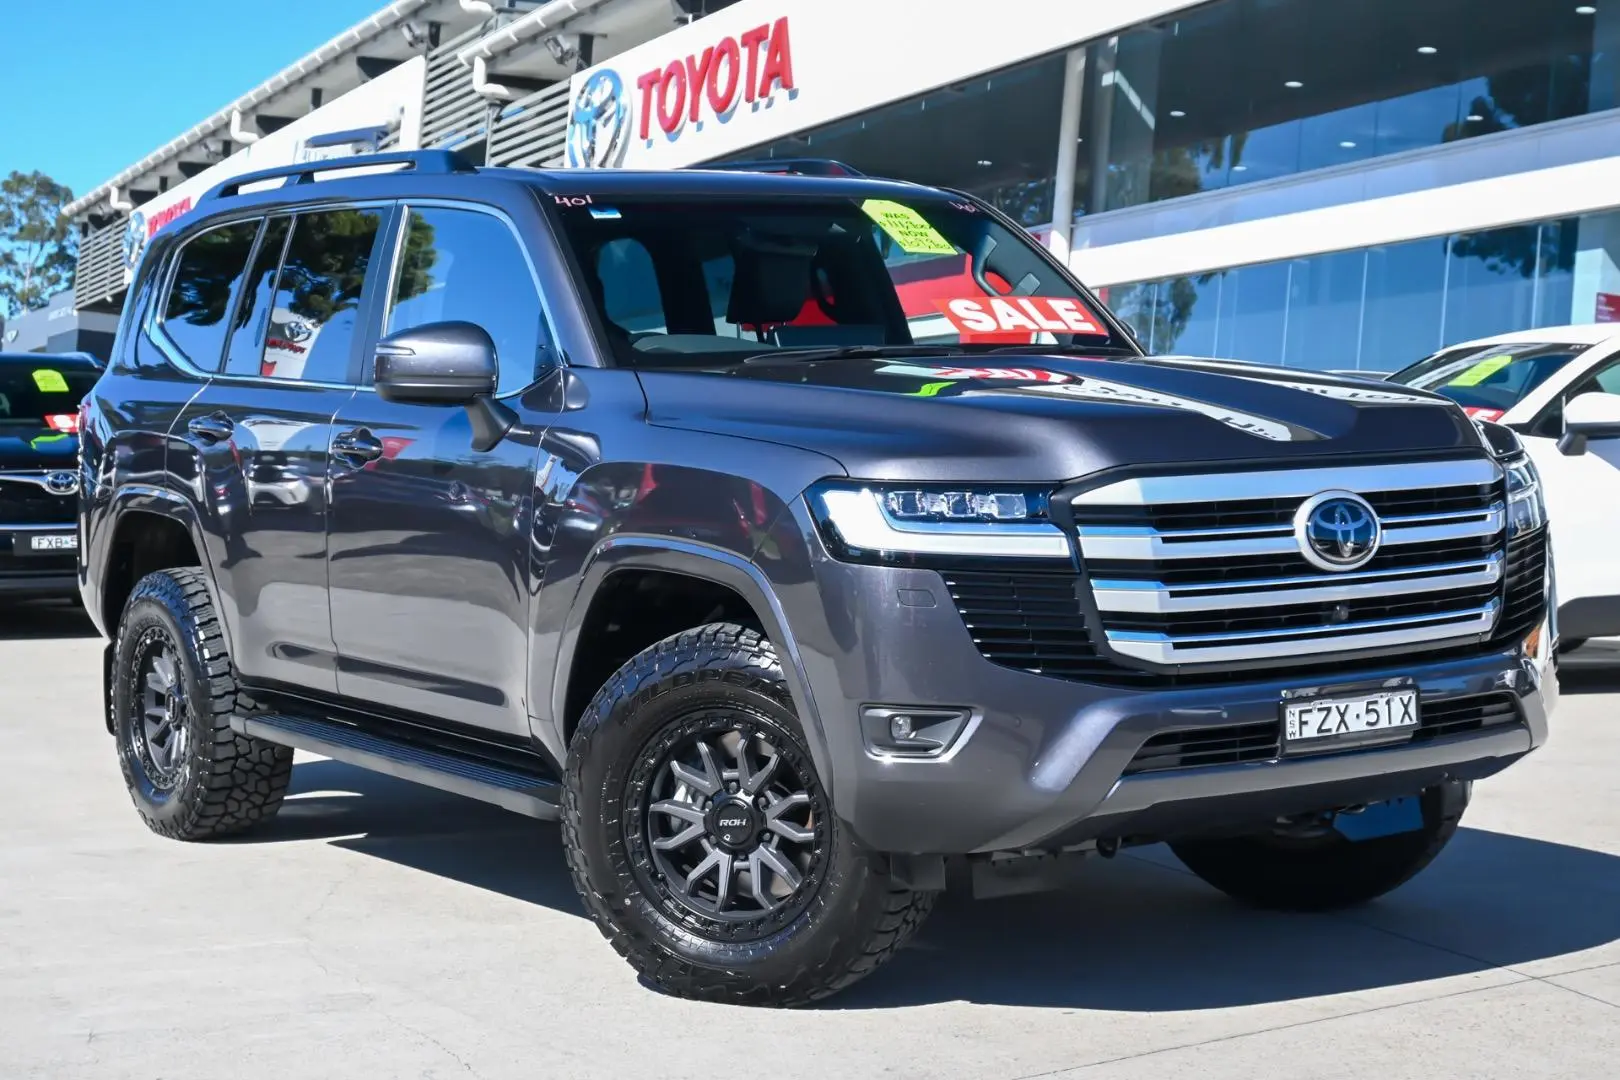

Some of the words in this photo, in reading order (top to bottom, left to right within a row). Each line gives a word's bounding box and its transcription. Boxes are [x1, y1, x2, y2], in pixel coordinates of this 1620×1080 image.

[637, 16, 794, 140] TOYOTA
[554, 194, 593, 207] 401
[948, 298, 1096, 332] SALE
